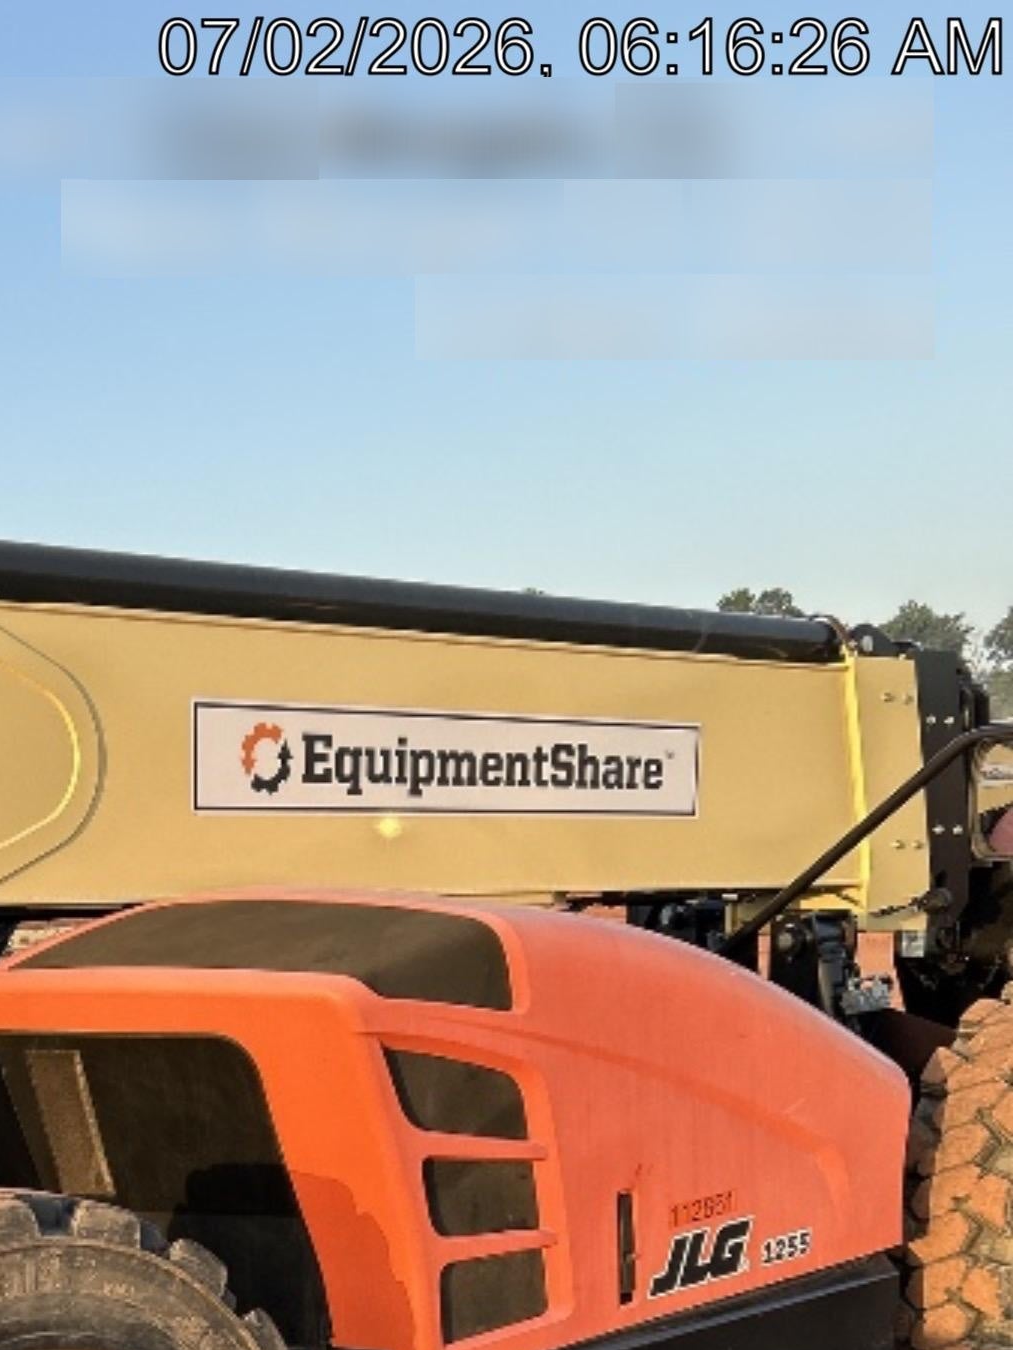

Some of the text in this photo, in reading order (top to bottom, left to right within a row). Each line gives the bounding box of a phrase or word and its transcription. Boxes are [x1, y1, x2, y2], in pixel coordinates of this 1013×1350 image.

[301, 733, 664, 797] EquipmentShare
[648, 1217, 811, 1298] JLG 1255
